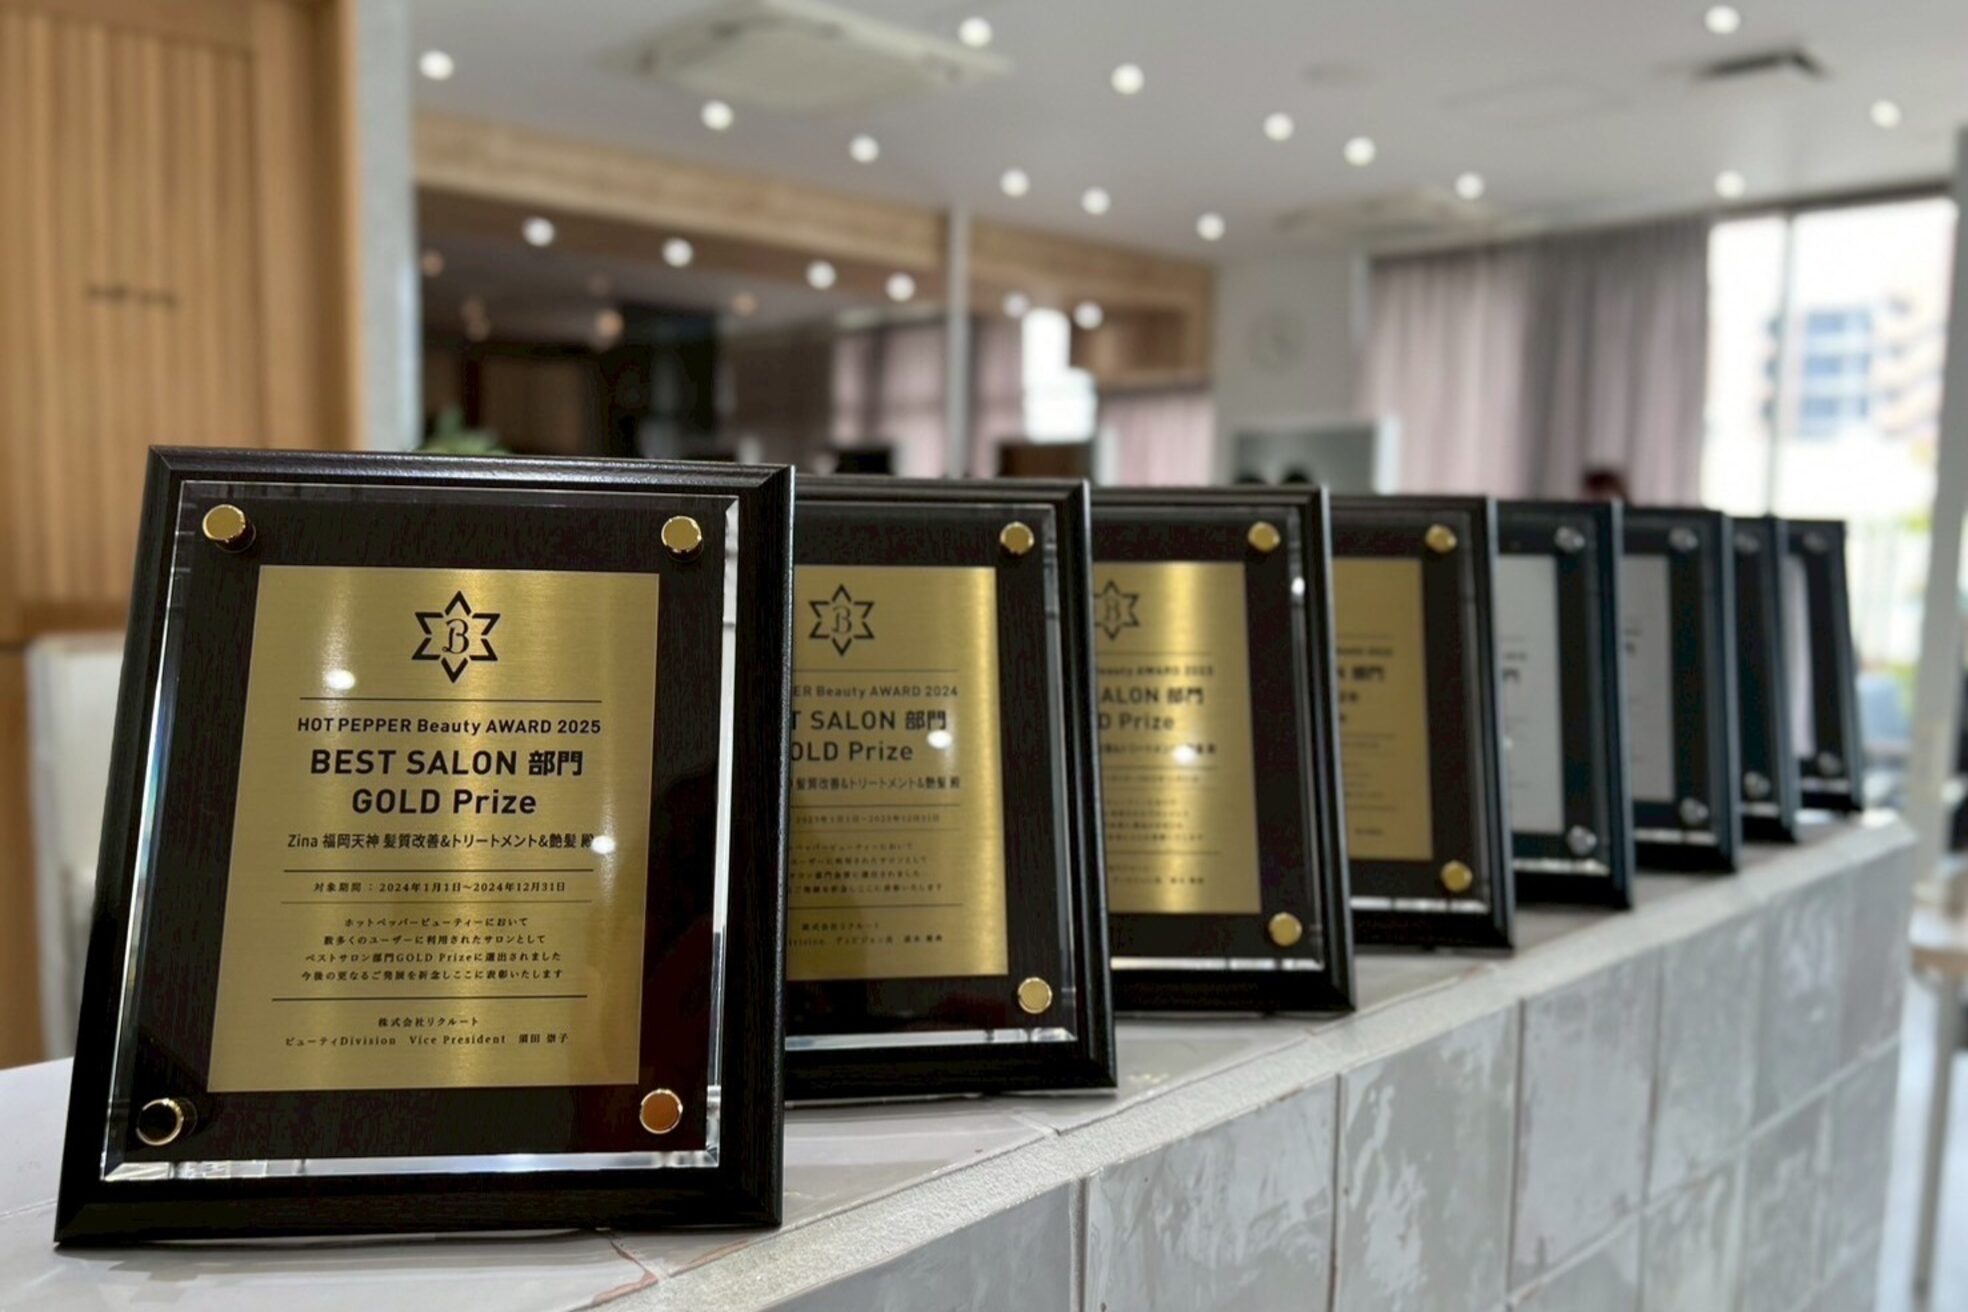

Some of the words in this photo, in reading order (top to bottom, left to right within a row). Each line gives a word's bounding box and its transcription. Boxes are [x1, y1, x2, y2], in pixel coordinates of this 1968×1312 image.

[441, 618, 470, 654] B
[816, 686, 865, 699] Beauty
[869, 685, 921, 697] AWARD
[925, 686, 958, 697] 2024
[1101, 686, 1159, 704] ALON
[297, 717, 335, 732] HOT
[338, 718, 412, 733] PEPPER
[417, 718, 481, 736] Beauty
[485, 719, 552, 734] AWARD
[557, 719, 602, 735] 2025
[810, 710, 896, 731] SALON
[905, 709, 947, 731] 部門
[1119, 712, 1175, 731] Prize
[791, 741, 839, 762] OLD
[849, 741, 914, 762] Prize
[310, 749, 397, 775] BEST
[406, 749, 518, 776] SALON
[528, 750, 584, 777] 部門
[352, 788, 441, 815] GOLD
[453, 788, 538, 815] Prize
[287, 834, 318, 849] Zina
[322, 833, 380, 849] 福岡天神
[377, 1016, 480, 1028] 株式会社リクルート
[409, 1034, 437, 1046] Vice
[443, 1034, 507, 1046] President
